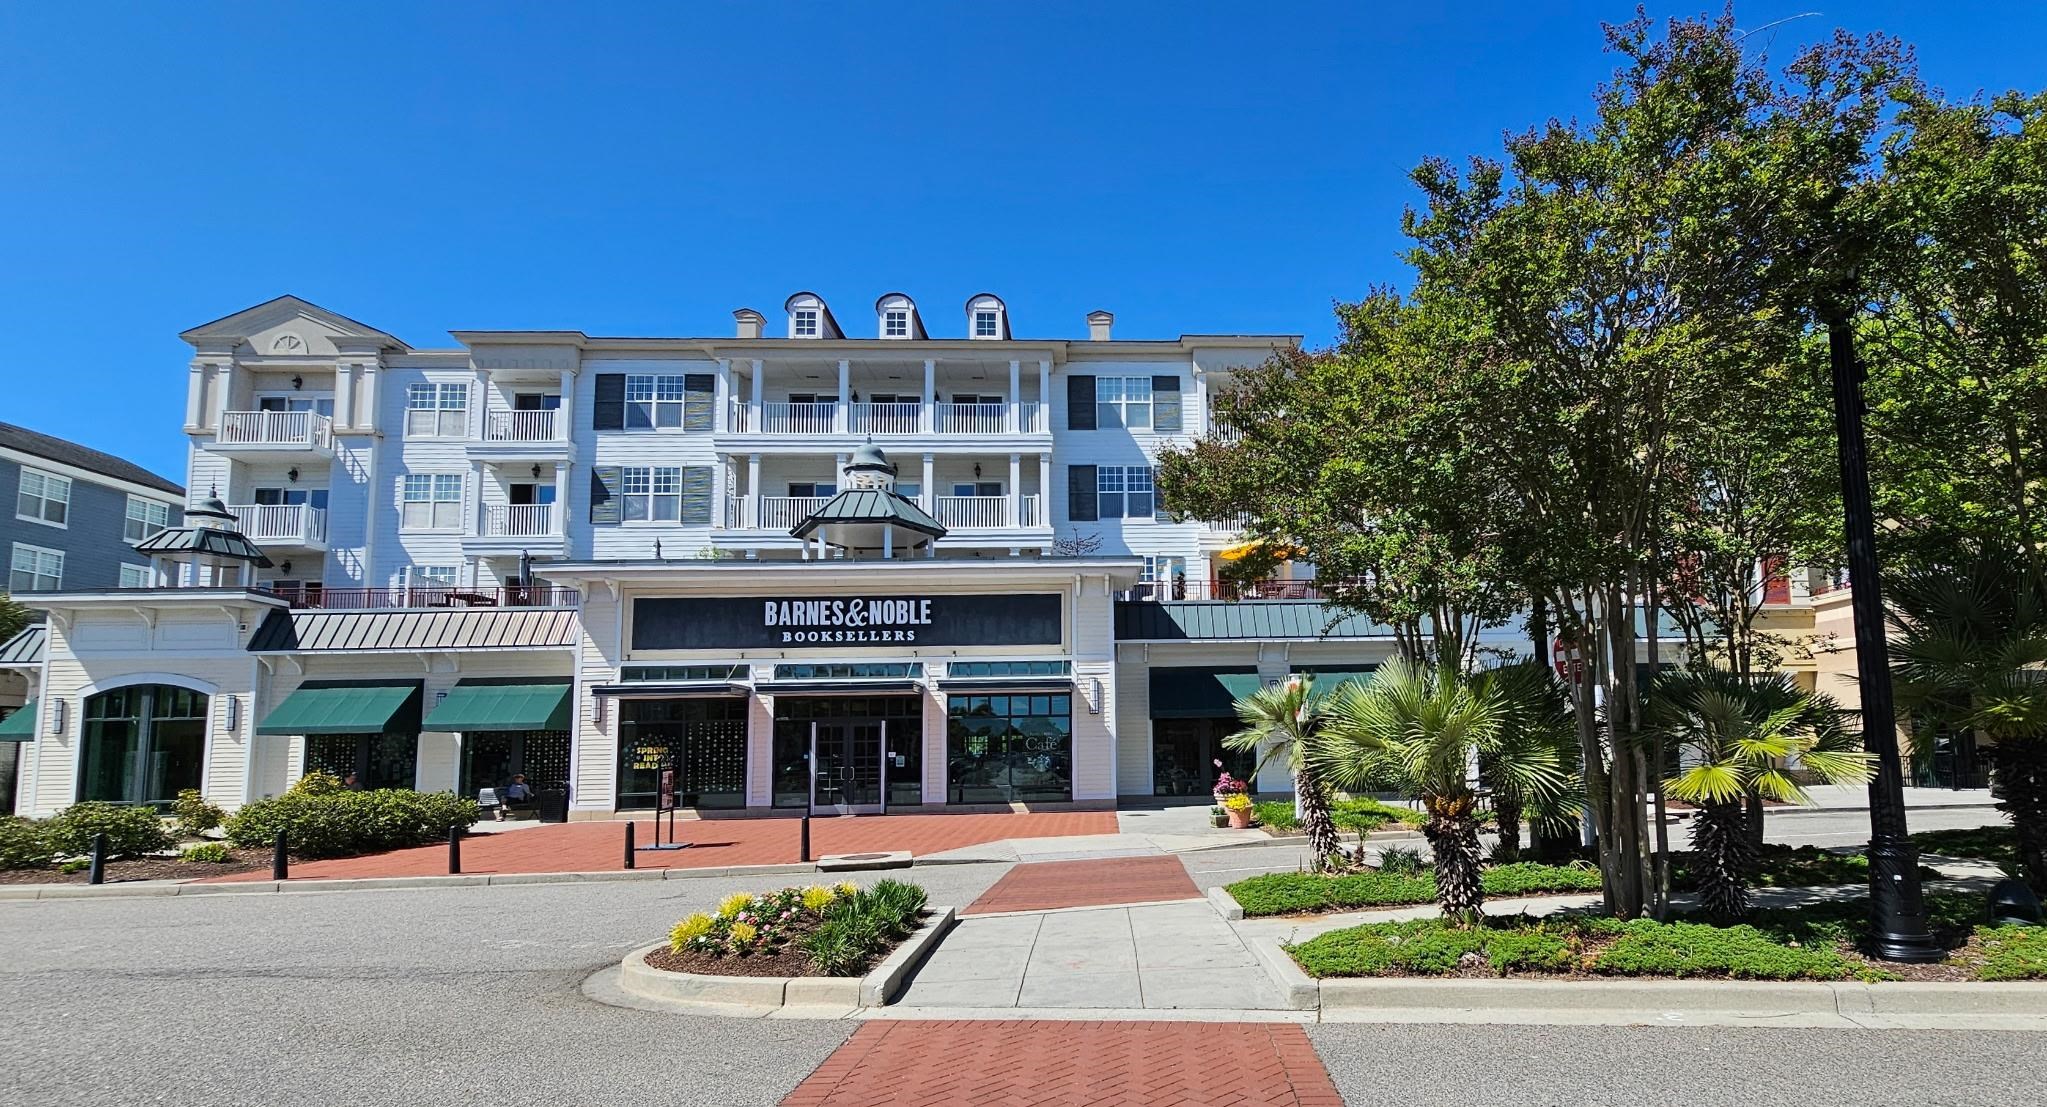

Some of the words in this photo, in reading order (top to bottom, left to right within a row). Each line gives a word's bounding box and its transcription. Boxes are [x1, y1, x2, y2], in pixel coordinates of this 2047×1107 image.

[782, 630, 915, 643] BOOKSELLERS
[1025, 736, 1058, 751] Café
[636, 746, 669, 755] SPRING
